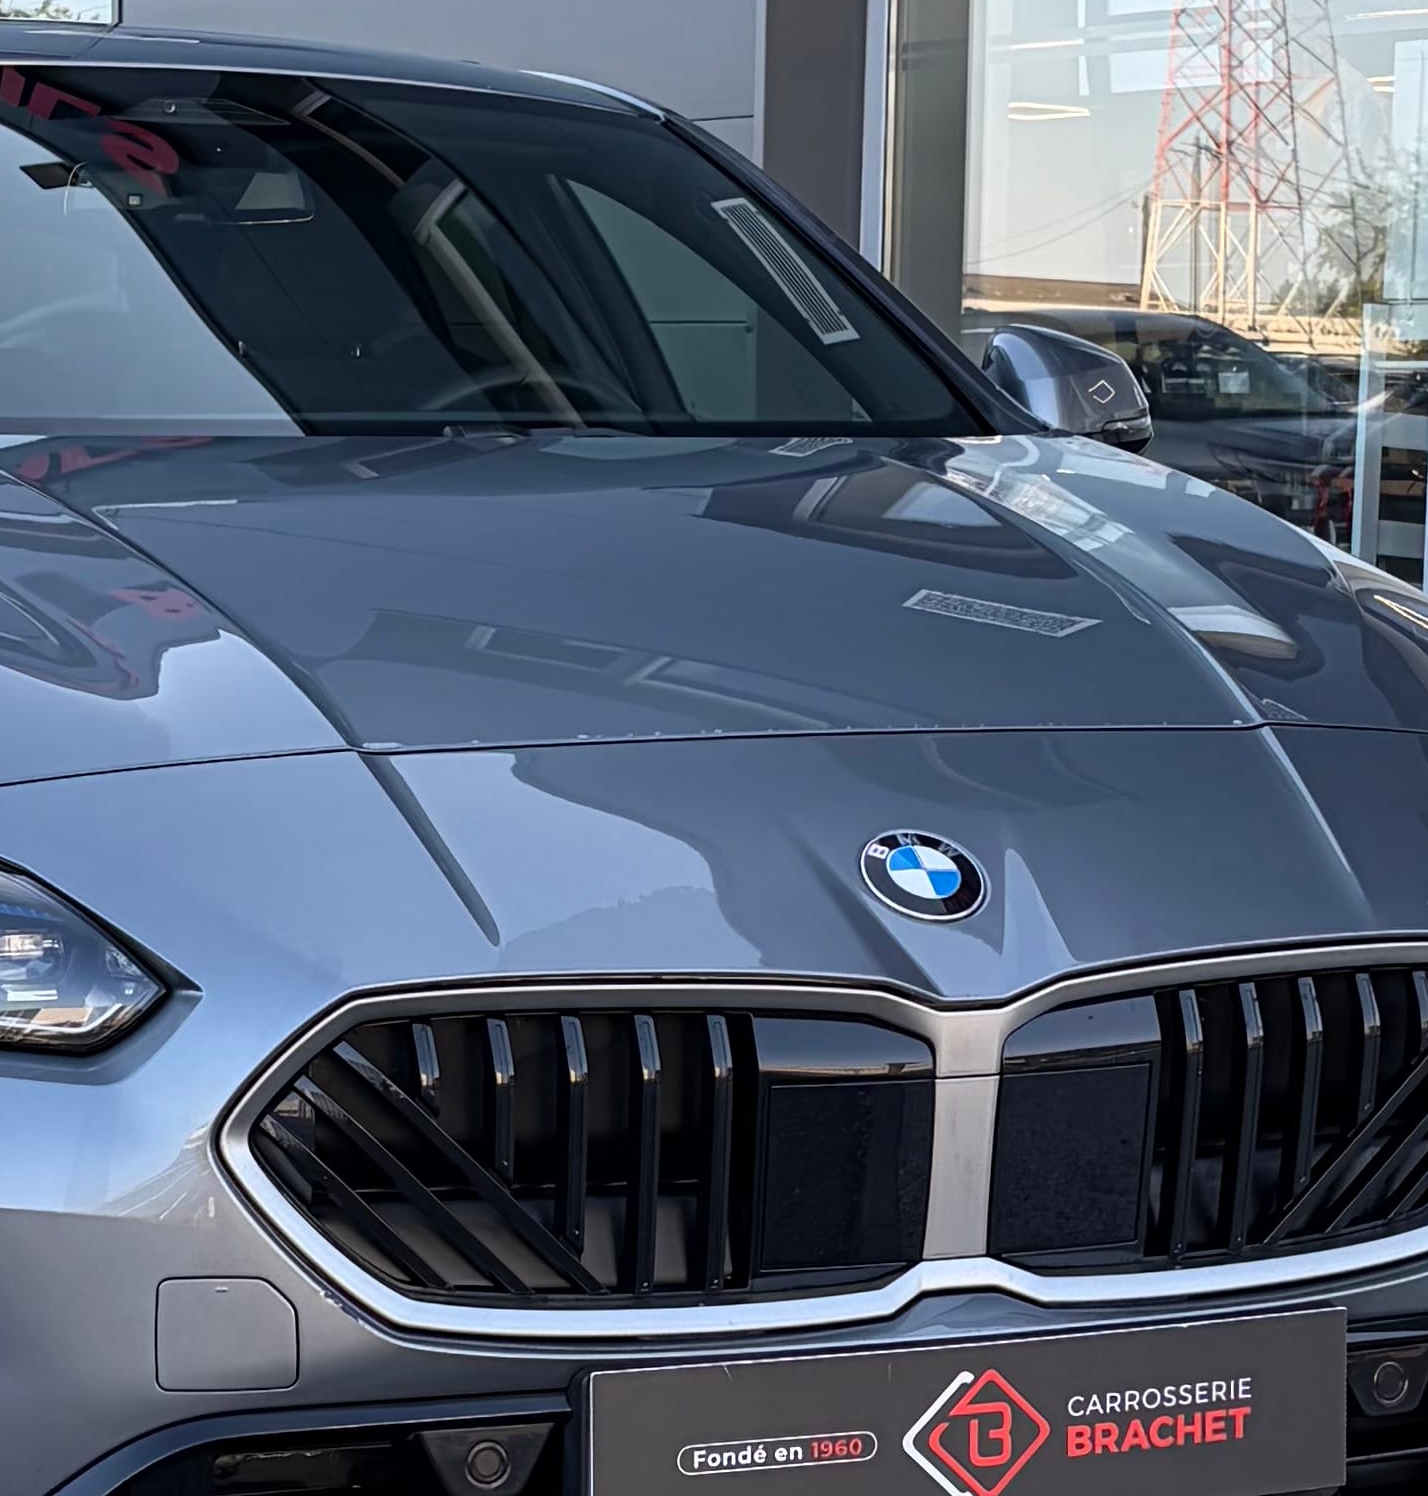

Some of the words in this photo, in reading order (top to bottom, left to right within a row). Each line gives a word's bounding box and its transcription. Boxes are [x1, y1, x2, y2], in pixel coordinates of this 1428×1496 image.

[1067, 1377, 1252, 1417] CARROSSERIE
[1066, 1407, 1252, 1457] BRACHET
[693, 1444, 767, 1469] Fondé
[774, 1446, 803, 1462] en
[809, 1437, 862, 1460] 1960
